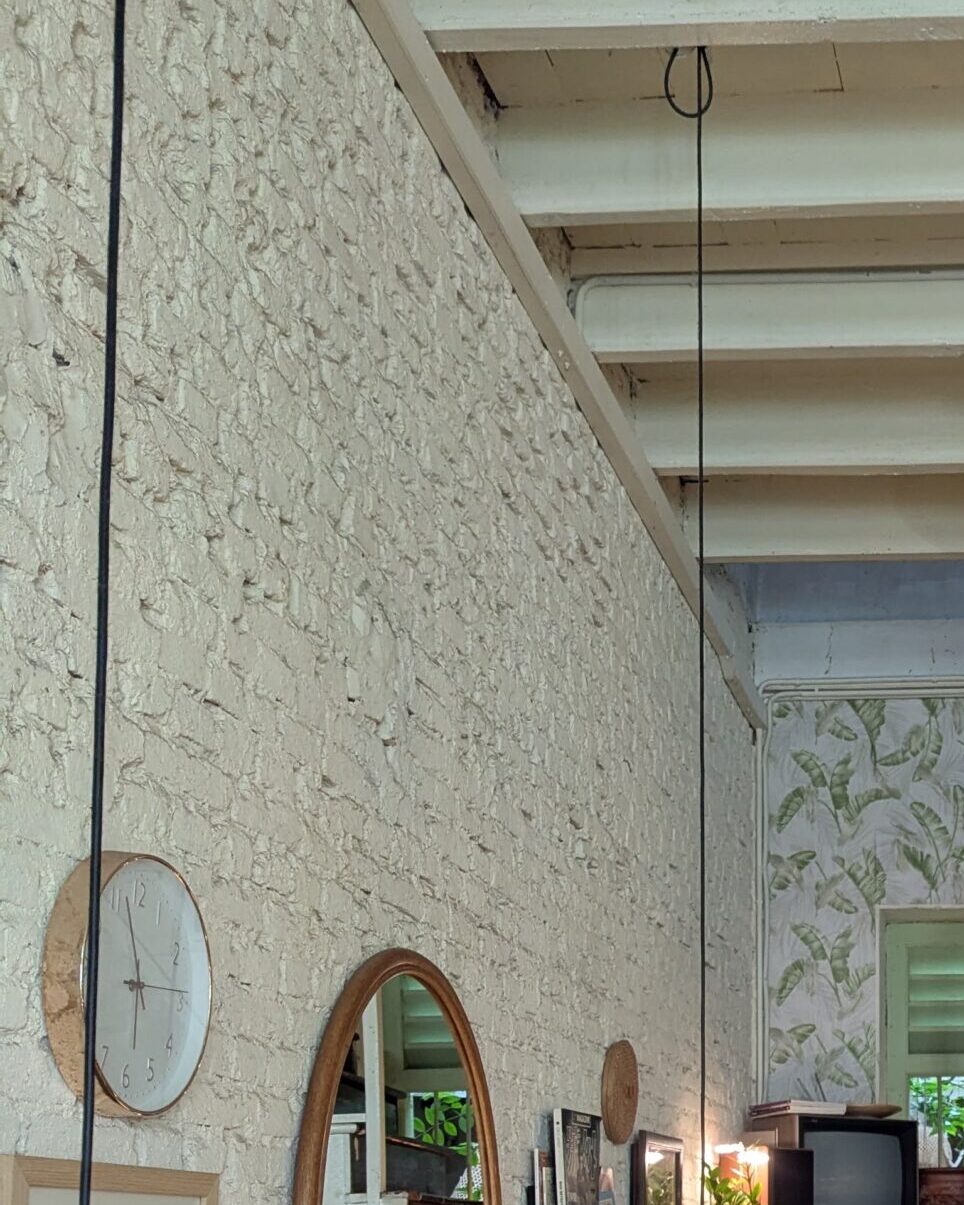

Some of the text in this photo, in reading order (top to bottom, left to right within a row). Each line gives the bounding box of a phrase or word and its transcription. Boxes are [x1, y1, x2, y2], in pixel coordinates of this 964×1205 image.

[111, 887, 122, 913] 11
[133, 879, 146, 908] 12
[172, 941, 180, 966] 2
[175, 992, 184, 1013] 3
[101, 1044, 109, 1068] 7
[165, 1033, 173, 1057] 4
[121, 1063, 130, 1089] 6
[146, 1057, 155, 1083] 5
